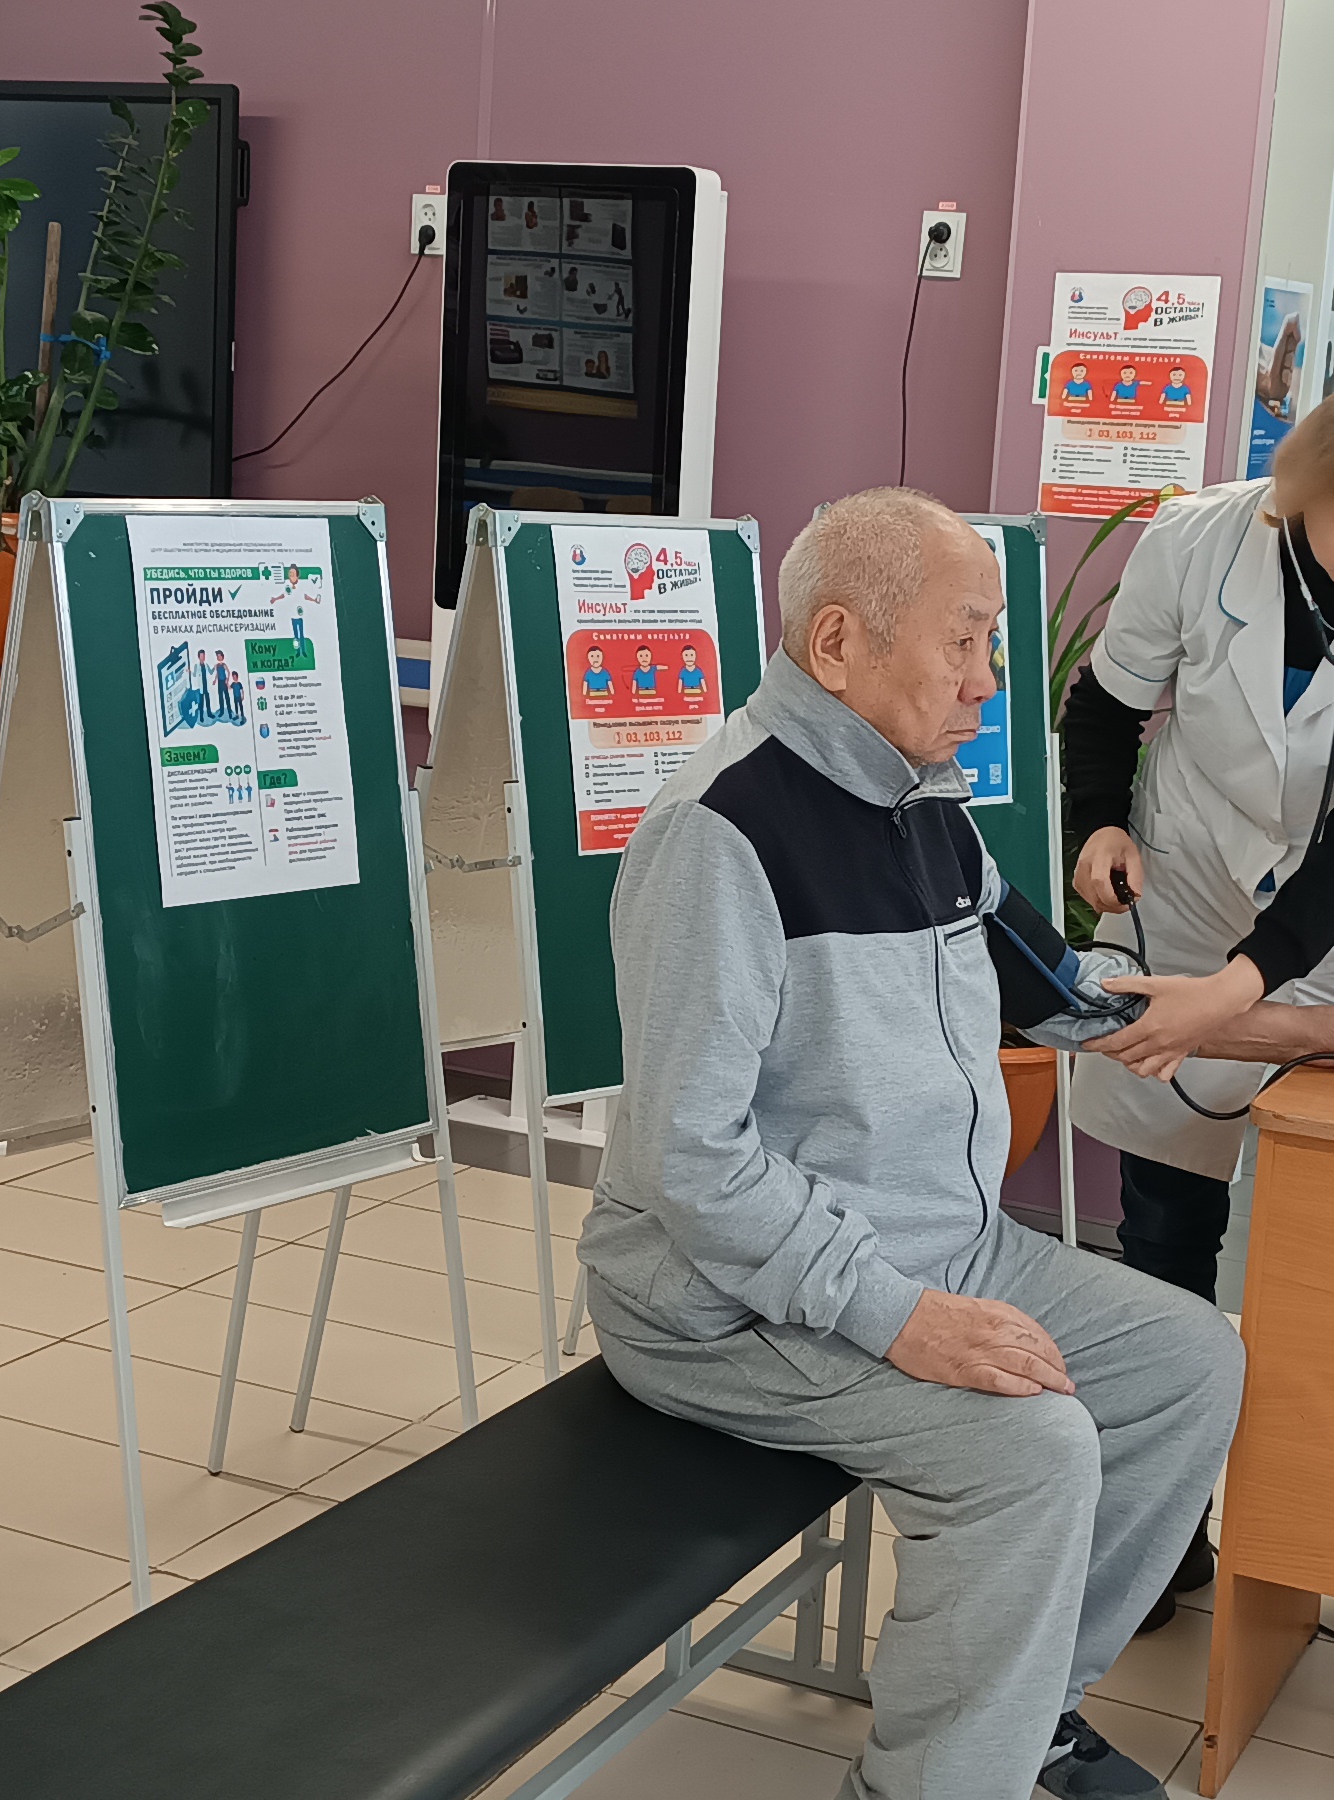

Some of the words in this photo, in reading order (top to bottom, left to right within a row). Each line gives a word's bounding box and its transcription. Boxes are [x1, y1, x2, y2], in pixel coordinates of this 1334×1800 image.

[1155, 290, 1186, 308] 4,5
[1154, 306, 1200, 315] ОСТАТЬСЯ
[1153, 317, 1163, 327] В
[1068, 328, 1119, 342] Инсульт
[1138, 431, 1157, 440] 112
[655, 547, 683, 568] 4,5
[145, 568, 187, 579] УБЕДИСЬ,
[189, 568, 204, 578] ЧТО
[205, 568, 218, 578] ТЫ
[219, 568, 252, 578] ЗДОРОВ
[657, 568, 697, 580] ОСТАТЬСЯ
[149, 583, 223, 607] ПРОЙДИ
[657, 583, 667, 595] В
[151, 609, 207, 621] БЕСПЛАТНОЕ
[209, 608, 275, 620] ОБСЛЕДОВАНИЕ
[577, 598, 627, 617] Инсульт
[153, 625, 159, 635] В
[160, 624, 195, 634] РАМКАХ
[195, 623, 277, 635] ДИСПАНСЕРИЗАЦИИ
[250, 642, 277, 657] Кому
[260, 656, 295, 670] когда?
[625, 732, 641, 744] 03,
[643, 731, 663, 743] 103,
[665, 730, 683, 742] 112
[164, 748, 207, 763] Зачем?
[263, 772, 288, 786] Где?
